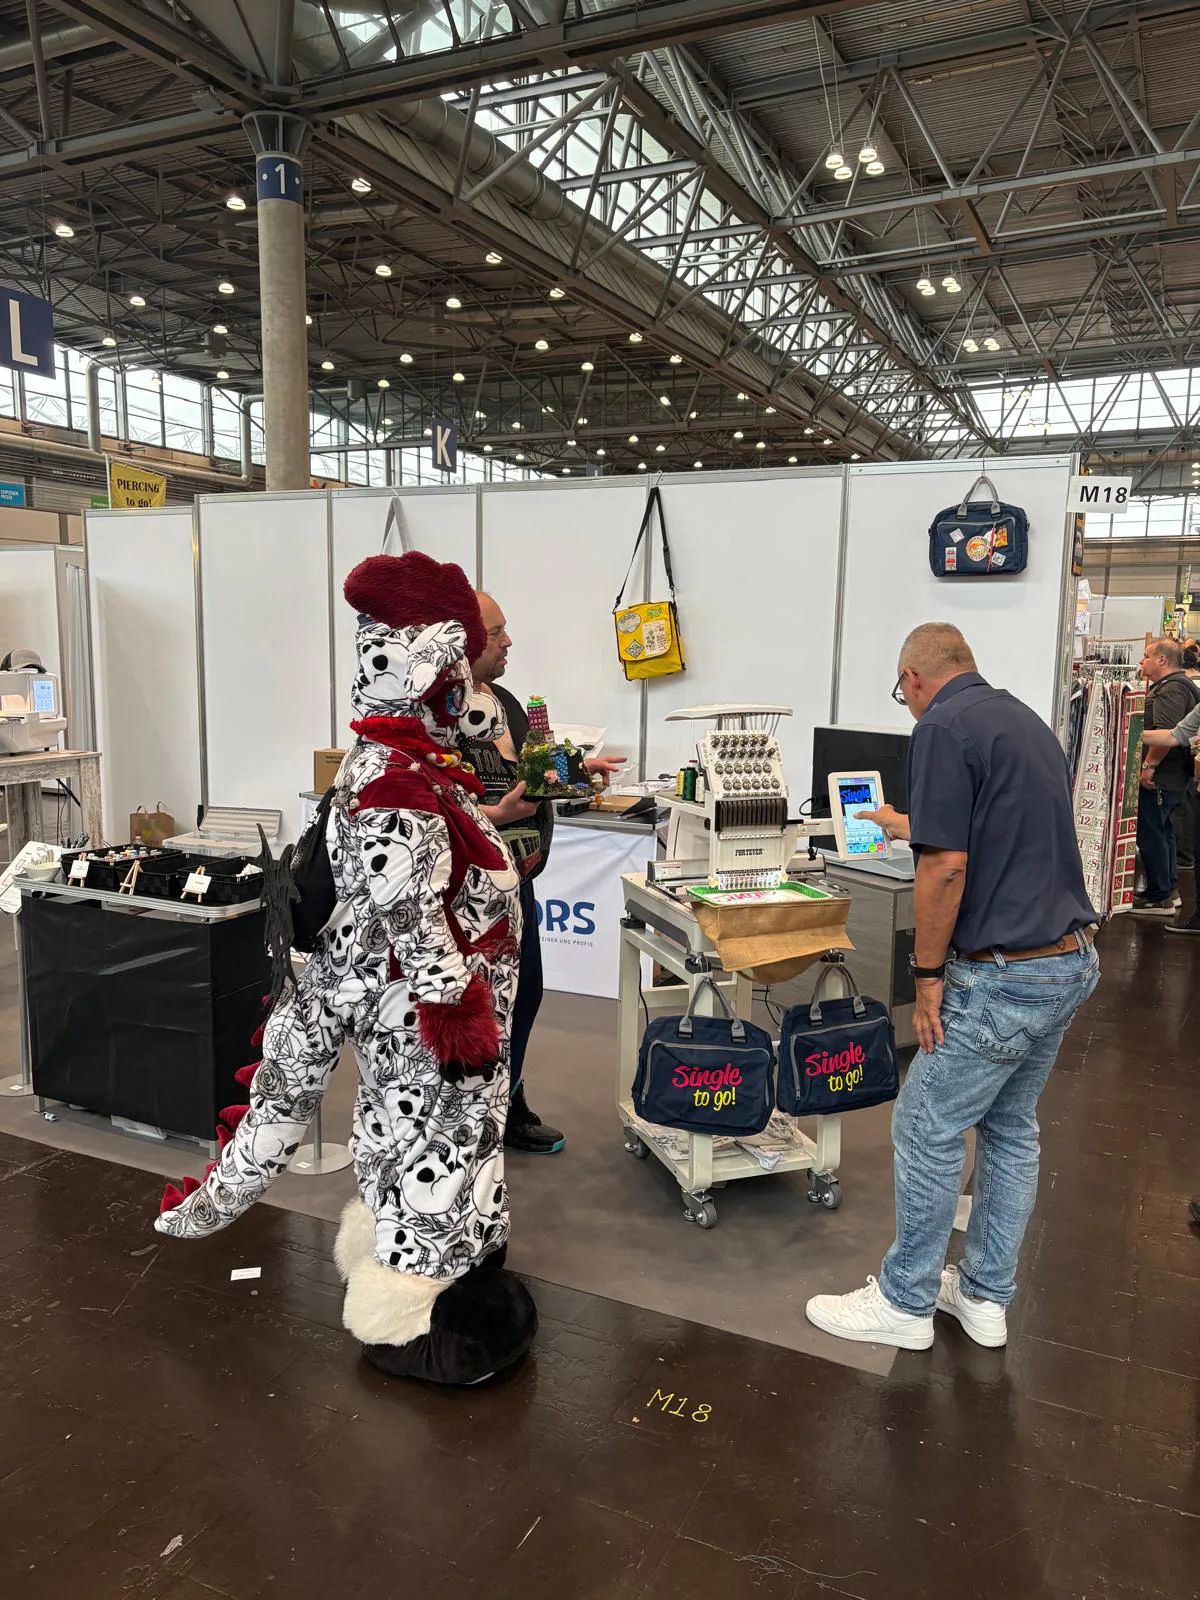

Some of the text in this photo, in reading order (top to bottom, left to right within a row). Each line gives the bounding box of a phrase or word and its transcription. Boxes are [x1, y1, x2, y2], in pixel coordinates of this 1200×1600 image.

[274, 163, 286, 194] 1
[9, 298, 39, 366] L
[436, 425, 452, 467] K
[116, 478, 159, 493] PIERCING
[1080, 485, 1128, 504] M18
[126, 497, 152, 508] to go!
[839, 786, 871, 804] Single
[534, 899, 596, 935] RS
[803, 1041, 865, 1077] Single
[671, 1062, 743, 1091] Single
[827, 1064, 863, 1092] to go!
[693, 1086, 736, 1111] to go!
[645, 1388, 713, 1423] M18
